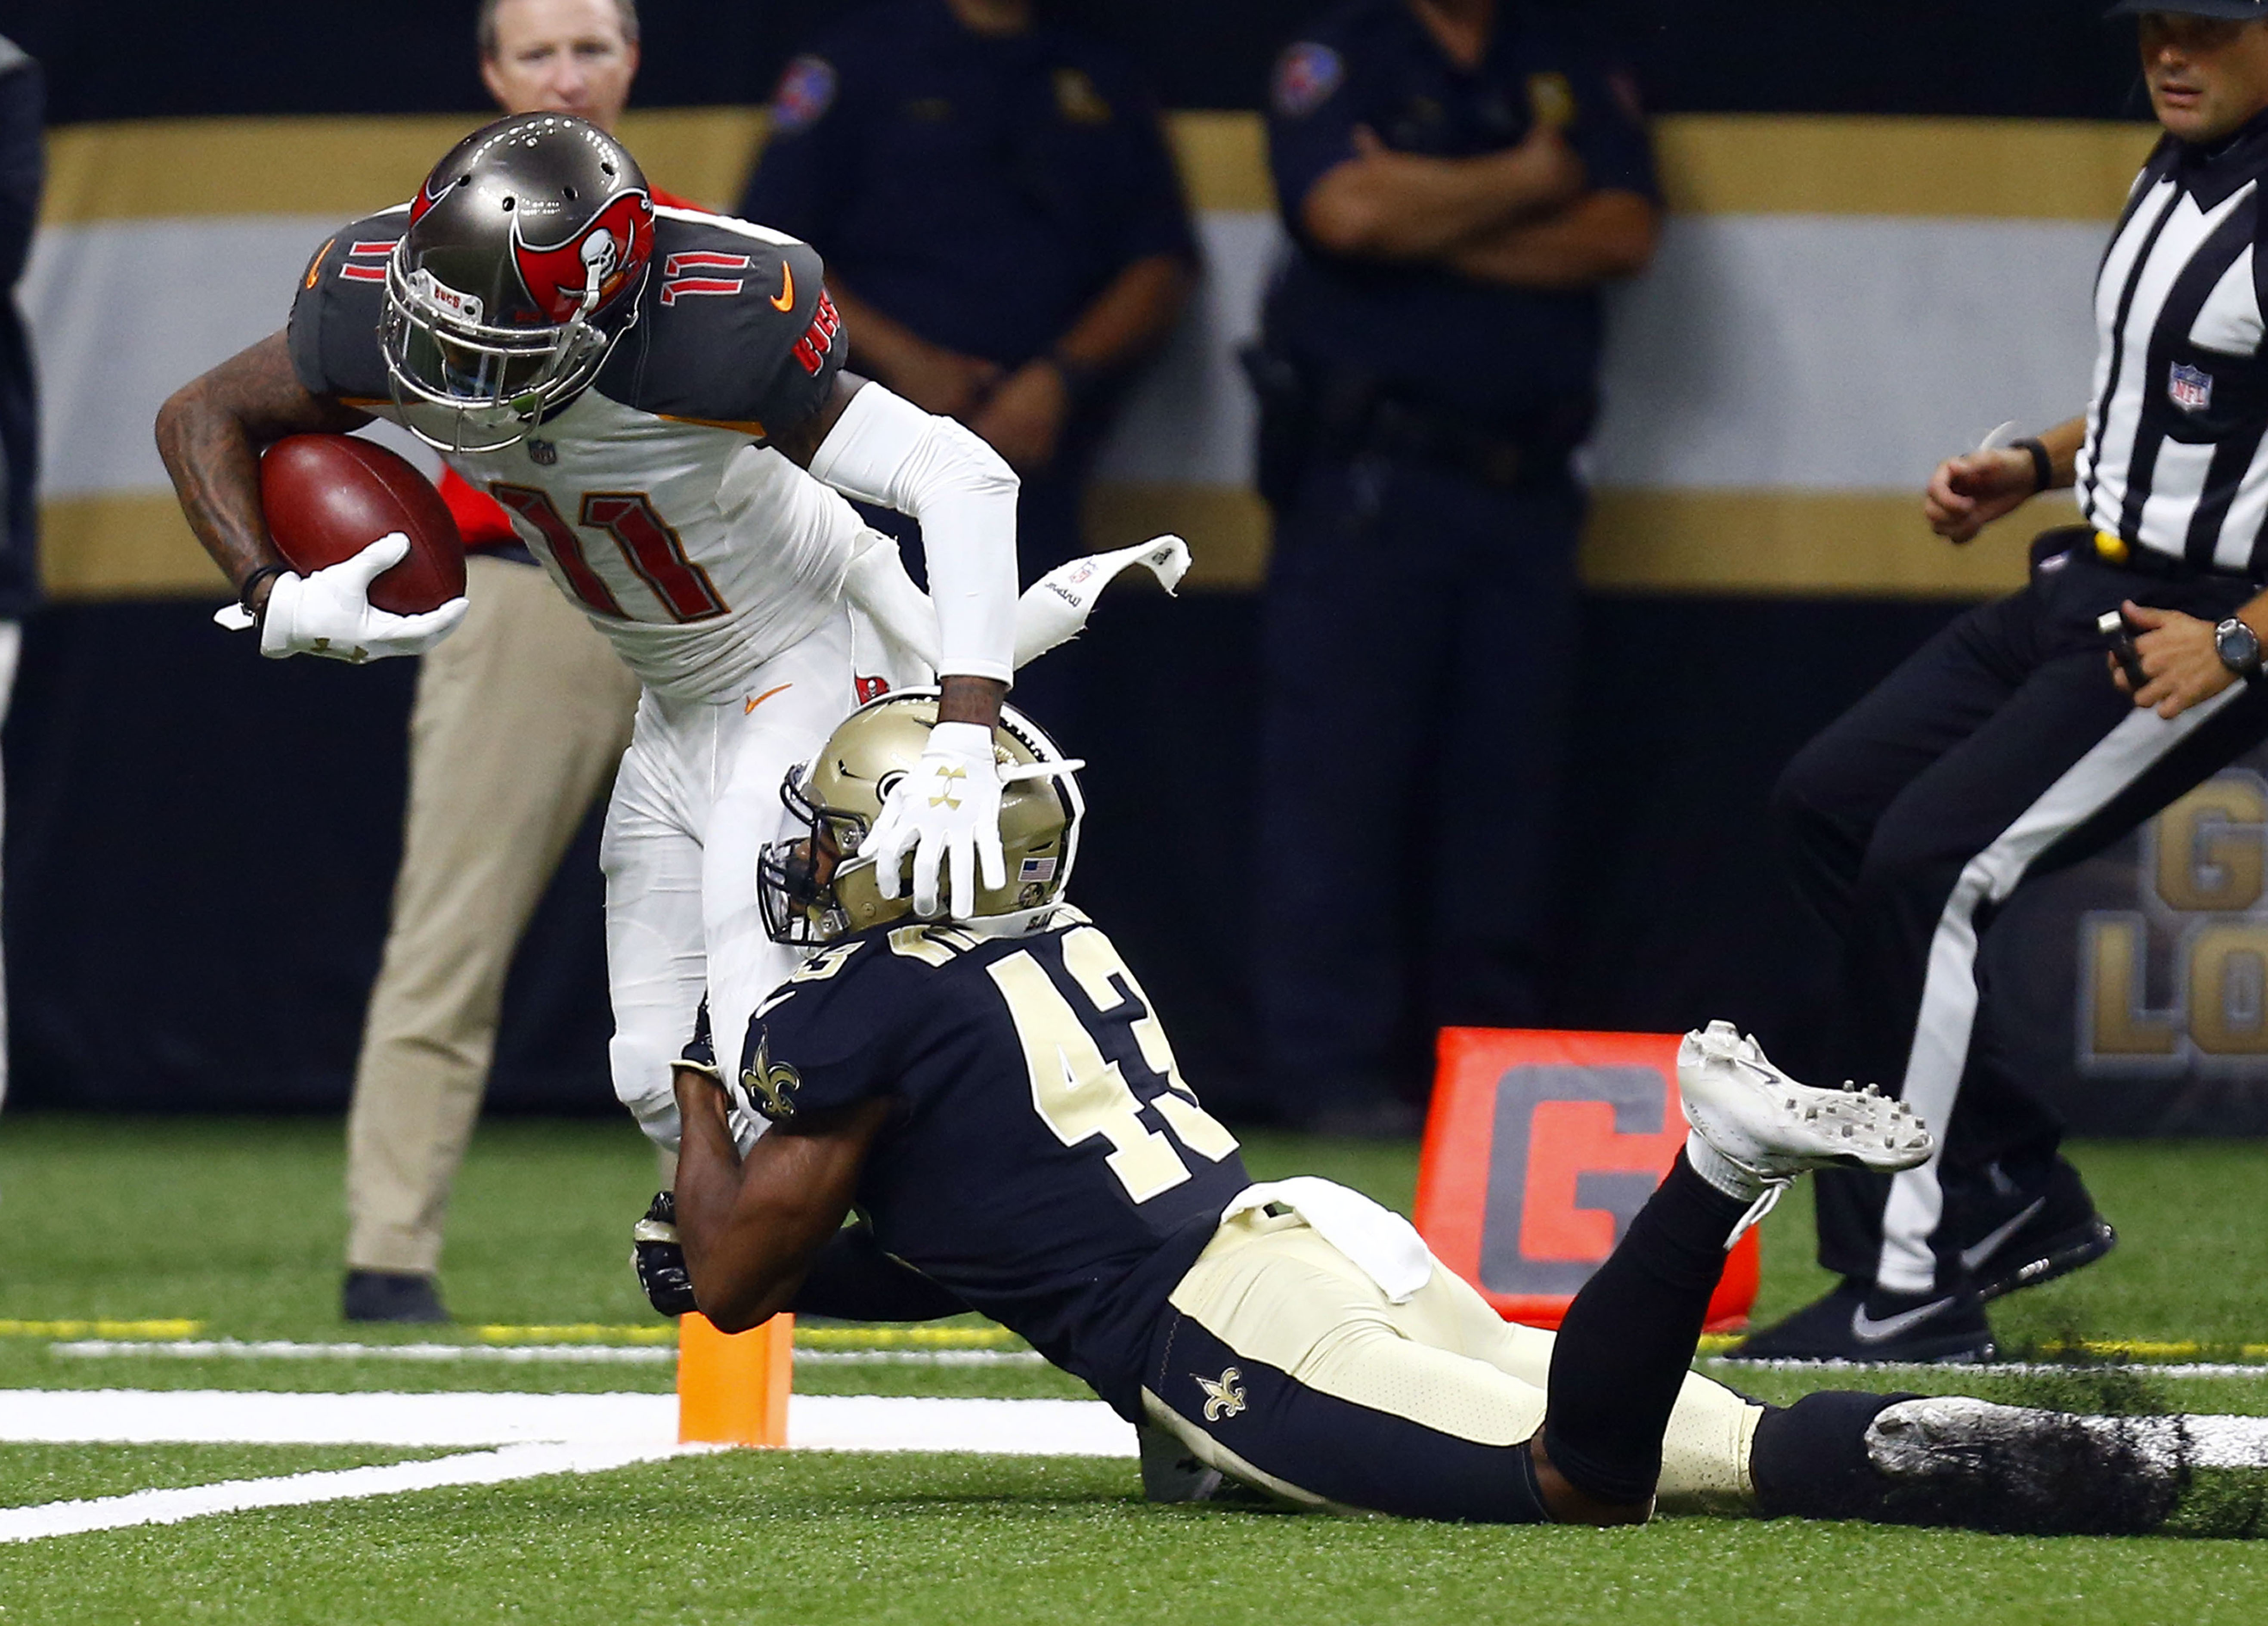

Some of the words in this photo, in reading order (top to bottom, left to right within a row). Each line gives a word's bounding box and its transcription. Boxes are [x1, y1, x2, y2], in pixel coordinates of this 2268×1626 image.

[489, 481, 732, 623] 11
[985, 924, 1241, 1204] 43
[1478, 1062, 1668, 1295] G
